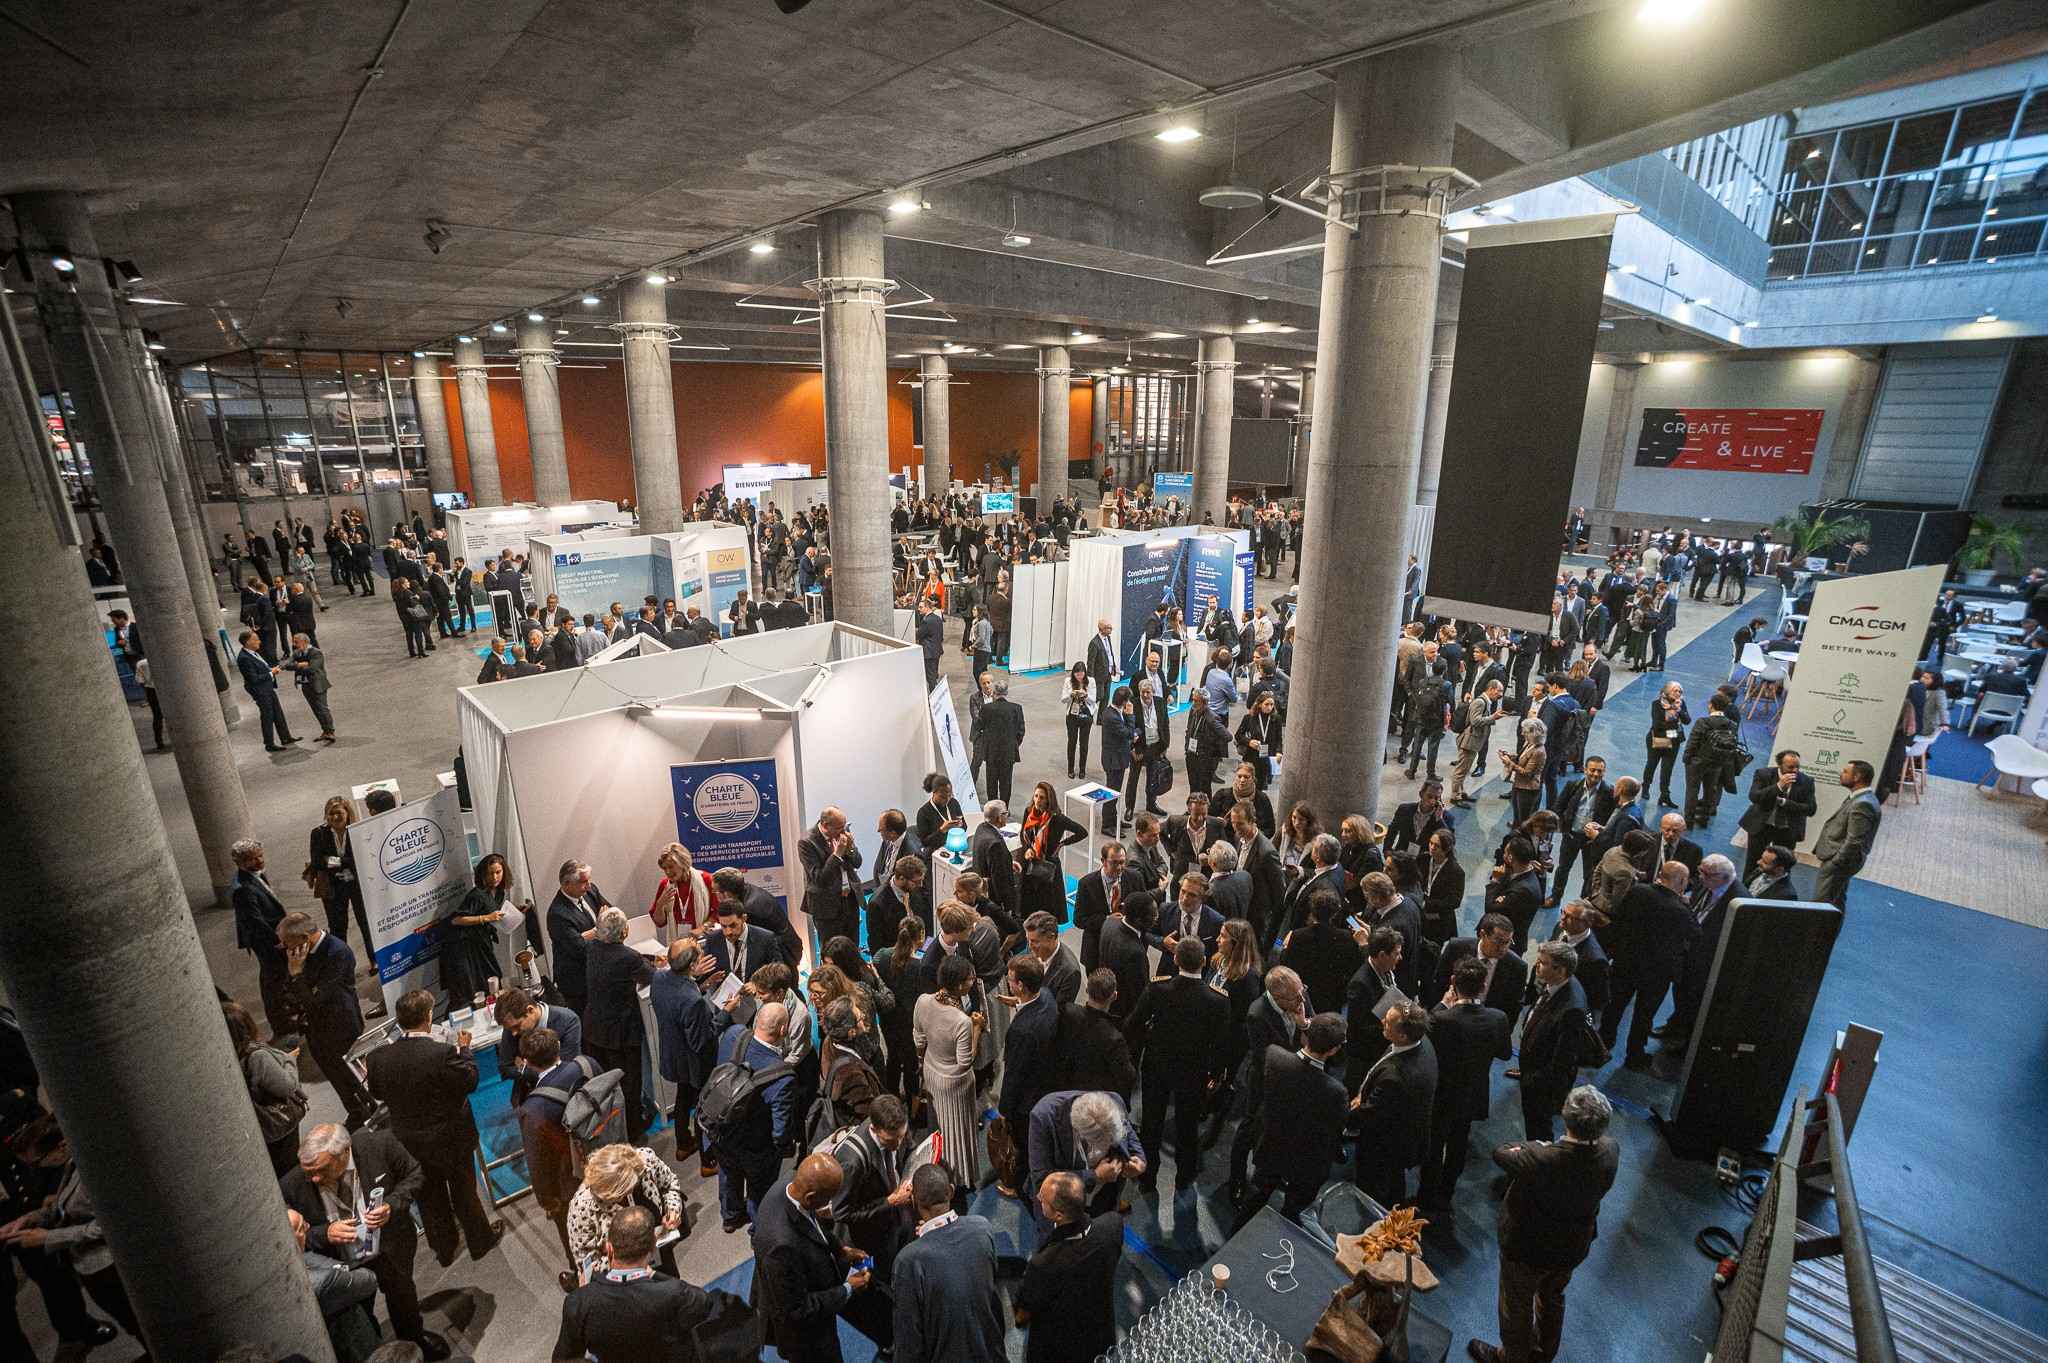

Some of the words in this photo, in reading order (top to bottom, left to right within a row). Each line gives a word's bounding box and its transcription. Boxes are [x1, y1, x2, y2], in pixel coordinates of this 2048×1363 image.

[1663, 422, 1732, 434] CREATE
[1717, 440, 1732, 456] &
[1742, 446, 1784, 458] LIVE
[736, 481, 772, 489] BIENVENUE
[1148, 550, 1164, 559] RWE
[1829, 615, 1866, 628] CMA
[1867, 618, 1906, 632] CGM
[1822, 644, 1862, 654] BETTER
[1866, 648, 1897, 658] WAYS
[705, 784, 744, 794] CHARTE
[710, 792, 742, 802] BLEUE
[389, 824, 430, 847] CHARTE
[395, 837, 428, 855] BLEUE
[389, 899, 408, 914] POUR
[408, 896, 418, 906] UN
[377, 917, 385, 926] ET
[386, 912, 400, 922] DES
